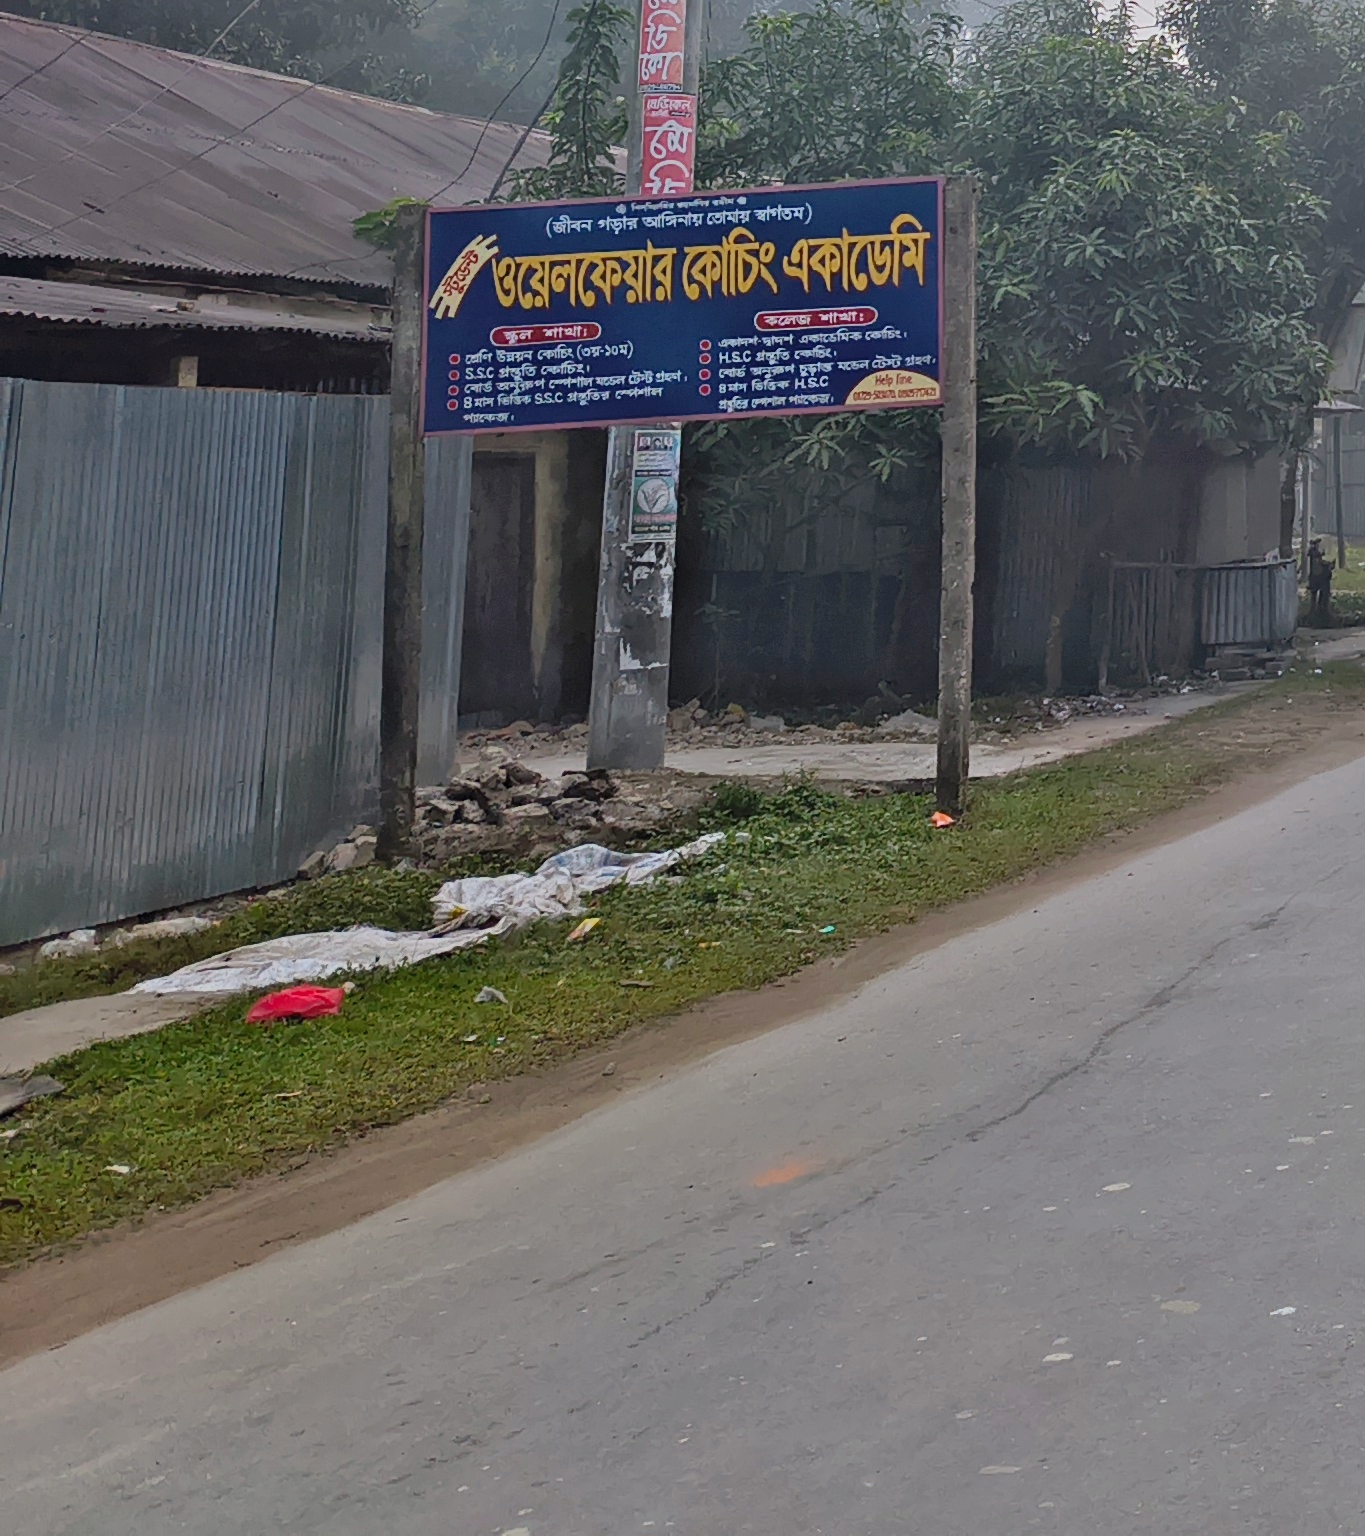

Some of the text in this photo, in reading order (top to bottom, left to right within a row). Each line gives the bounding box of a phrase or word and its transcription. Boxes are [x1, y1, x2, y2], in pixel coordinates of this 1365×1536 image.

[546, 215, 593, 239] (জীবন
[598, 214, 639, 235] গড়ার
[642, 210, 704, 229] আঙ্গিনায়
[707, 208, 752, 225] তোমায়
[754, 202, 813, 225] স্বাগতম)
[491, 213, 931, 310] ওয়েলফেয়ার কোচিং একাডেমি
[763, 314, 813, 327] কলেজ
[503, 329, 534, 345] স্কুল
[799, 327, 863, 344] একাডেমিক
[496, 348, 533, 363] উন্নয়ন
[537, 344, 574, 360] কোচিং
[498, 363, 536, 382] প্রস্তুতি
[718, 365, 747, 379] বোর্ড
[872, 354, 904, 370] টেস্ট
[464, 380, 493, 395] বোর্ড
[548, 374, 594, 390] স্পেশাল
[794, 376, 829, 390] H.S.C
